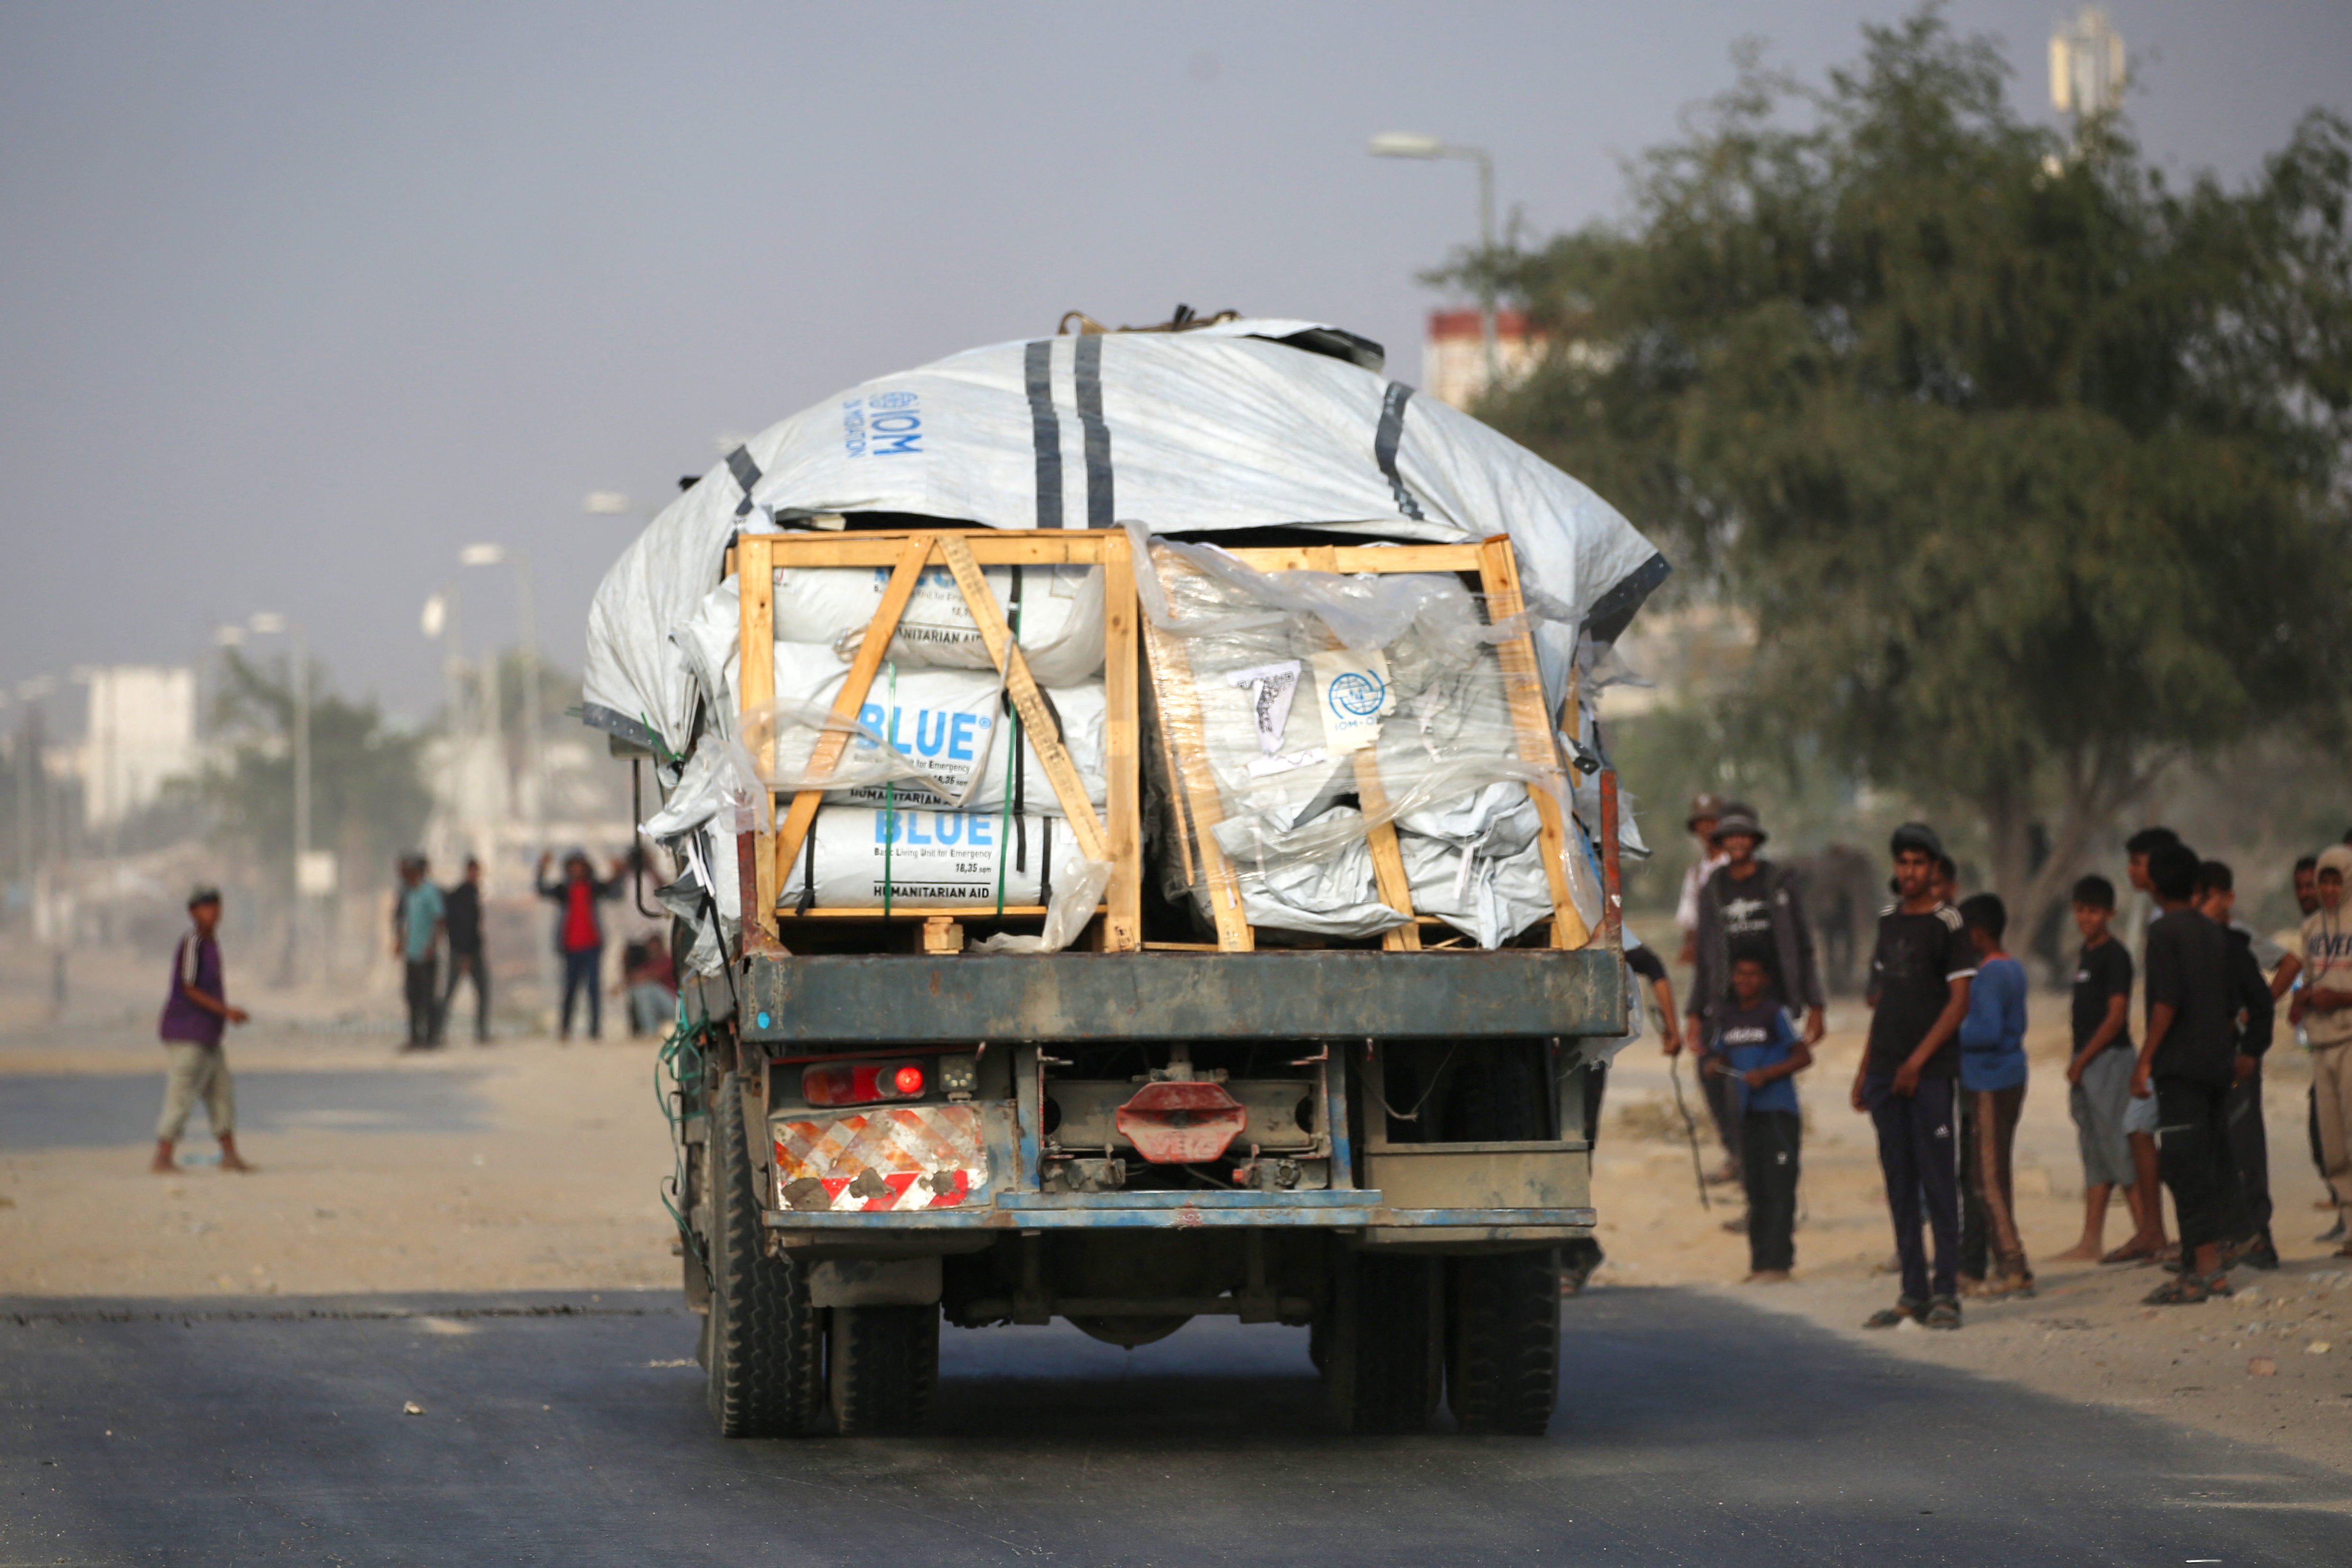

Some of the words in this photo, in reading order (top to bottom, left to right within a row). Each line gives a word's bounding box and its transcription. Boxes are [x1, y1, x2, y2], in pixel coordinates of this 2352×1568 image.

[871, 409, 923, 455] IOM
[928, 760, 971, 774] Emergency
[875, 810, 993, 846] BLUE
[950, 849, 992, 860] Emergency
[955, 863, 977, 874] 18,35
[969, 887, 990, 898] AID
